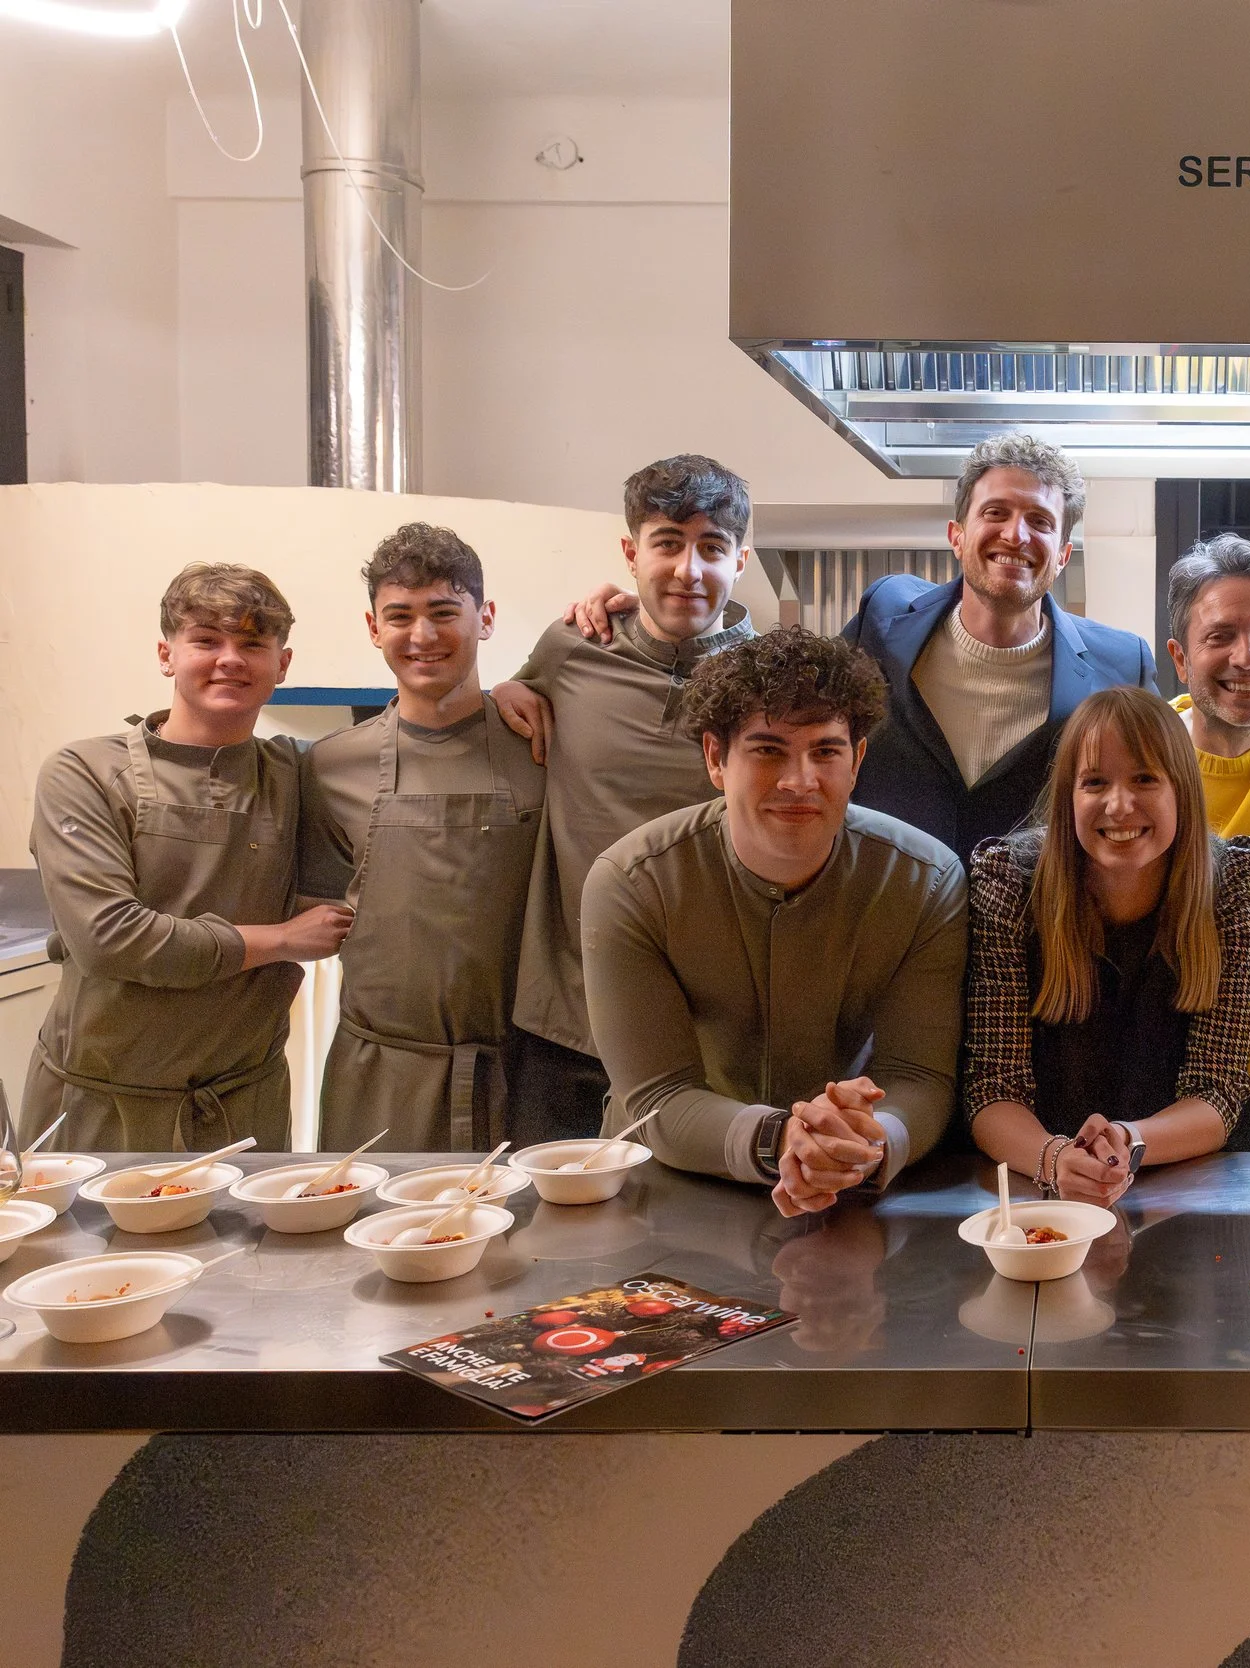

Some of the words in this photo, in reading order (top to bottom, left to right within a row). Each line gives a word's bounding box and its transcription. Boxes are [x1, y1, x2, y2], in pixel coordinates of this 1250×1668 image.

[623, 1280, 768, 1326] oscarwine
[408, 1347, 431, 1356] E
[420, 1351, 512, 1390] FAMIGLIA!
[428, 1341, 496, 1368] ANCHE
[502, 1368, 532, 1383] TE
